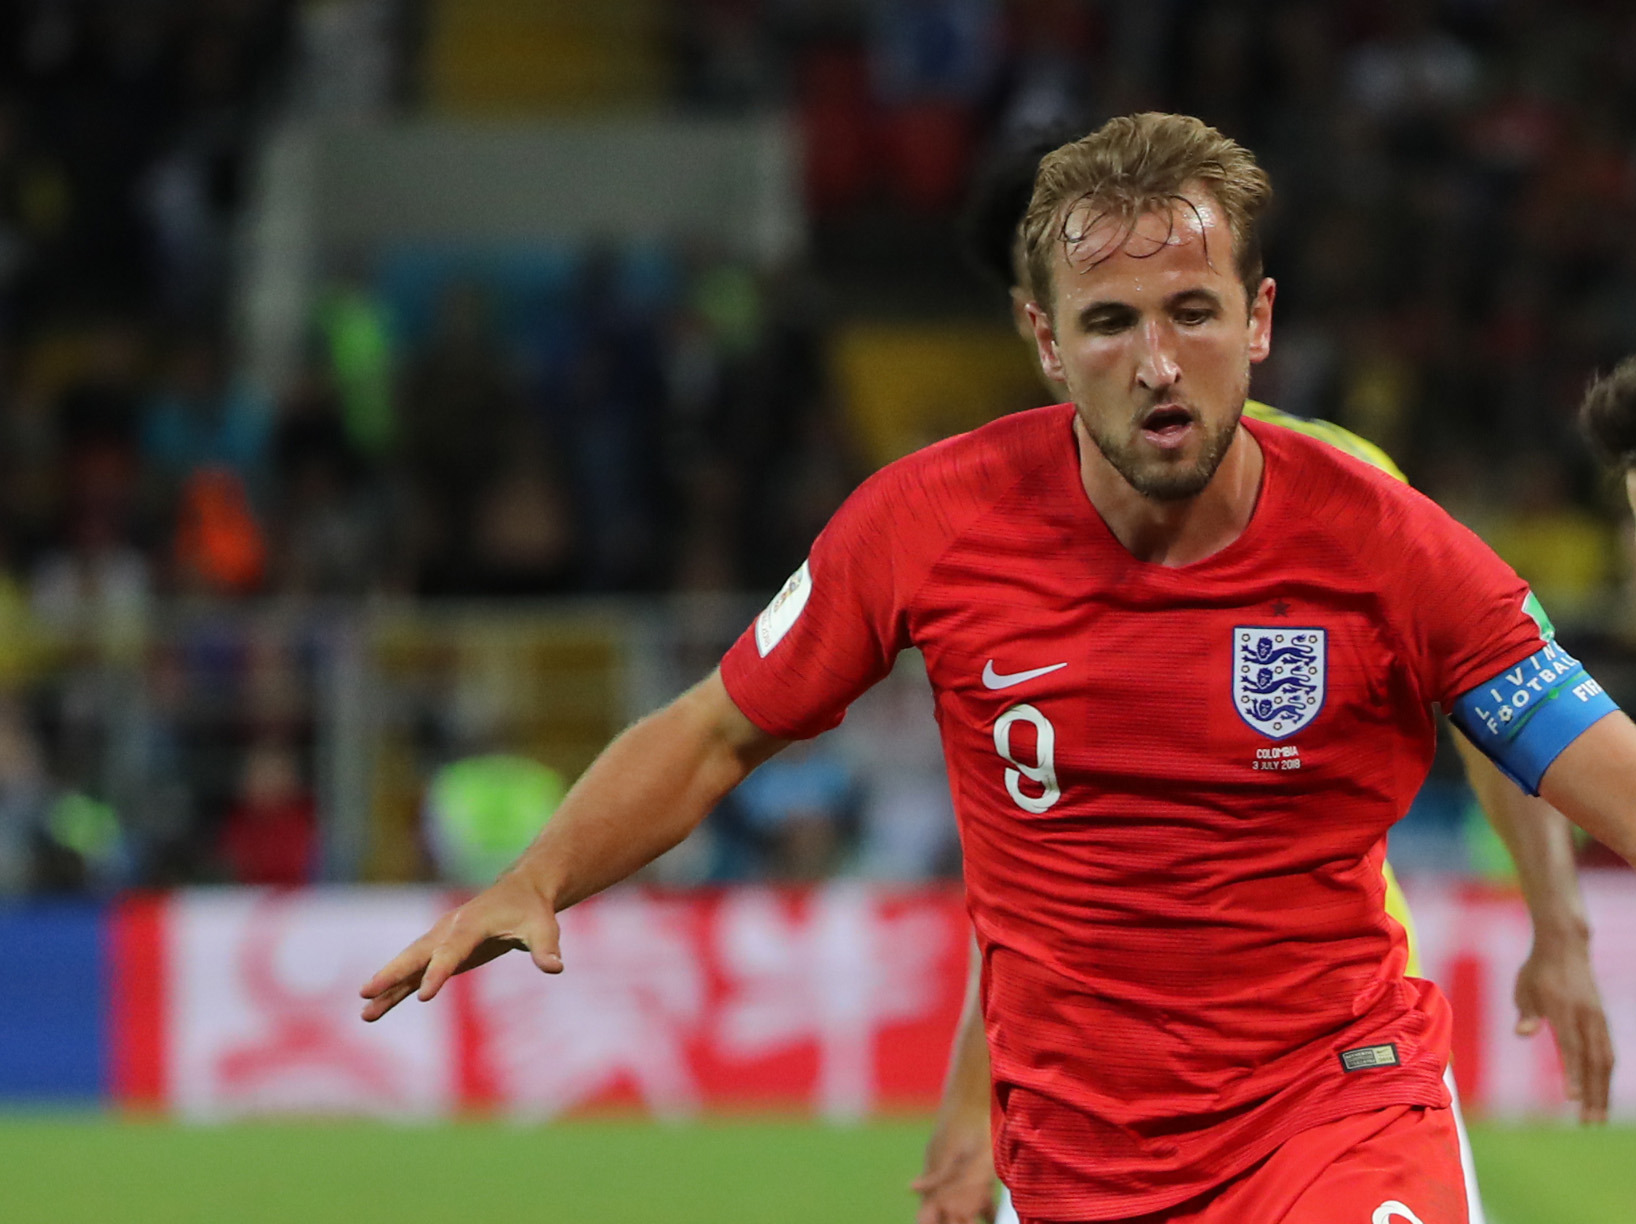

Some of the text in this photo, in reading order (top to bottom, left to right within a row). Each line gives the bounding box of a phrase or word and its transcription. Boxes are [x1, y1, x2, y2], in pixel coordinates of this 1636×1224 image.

[993, 703, 1061, 814] 9
[1256, 746, 1299, 759] COLOMBIA
[1252, 759, 1301, 770] 3 JULY 2018
